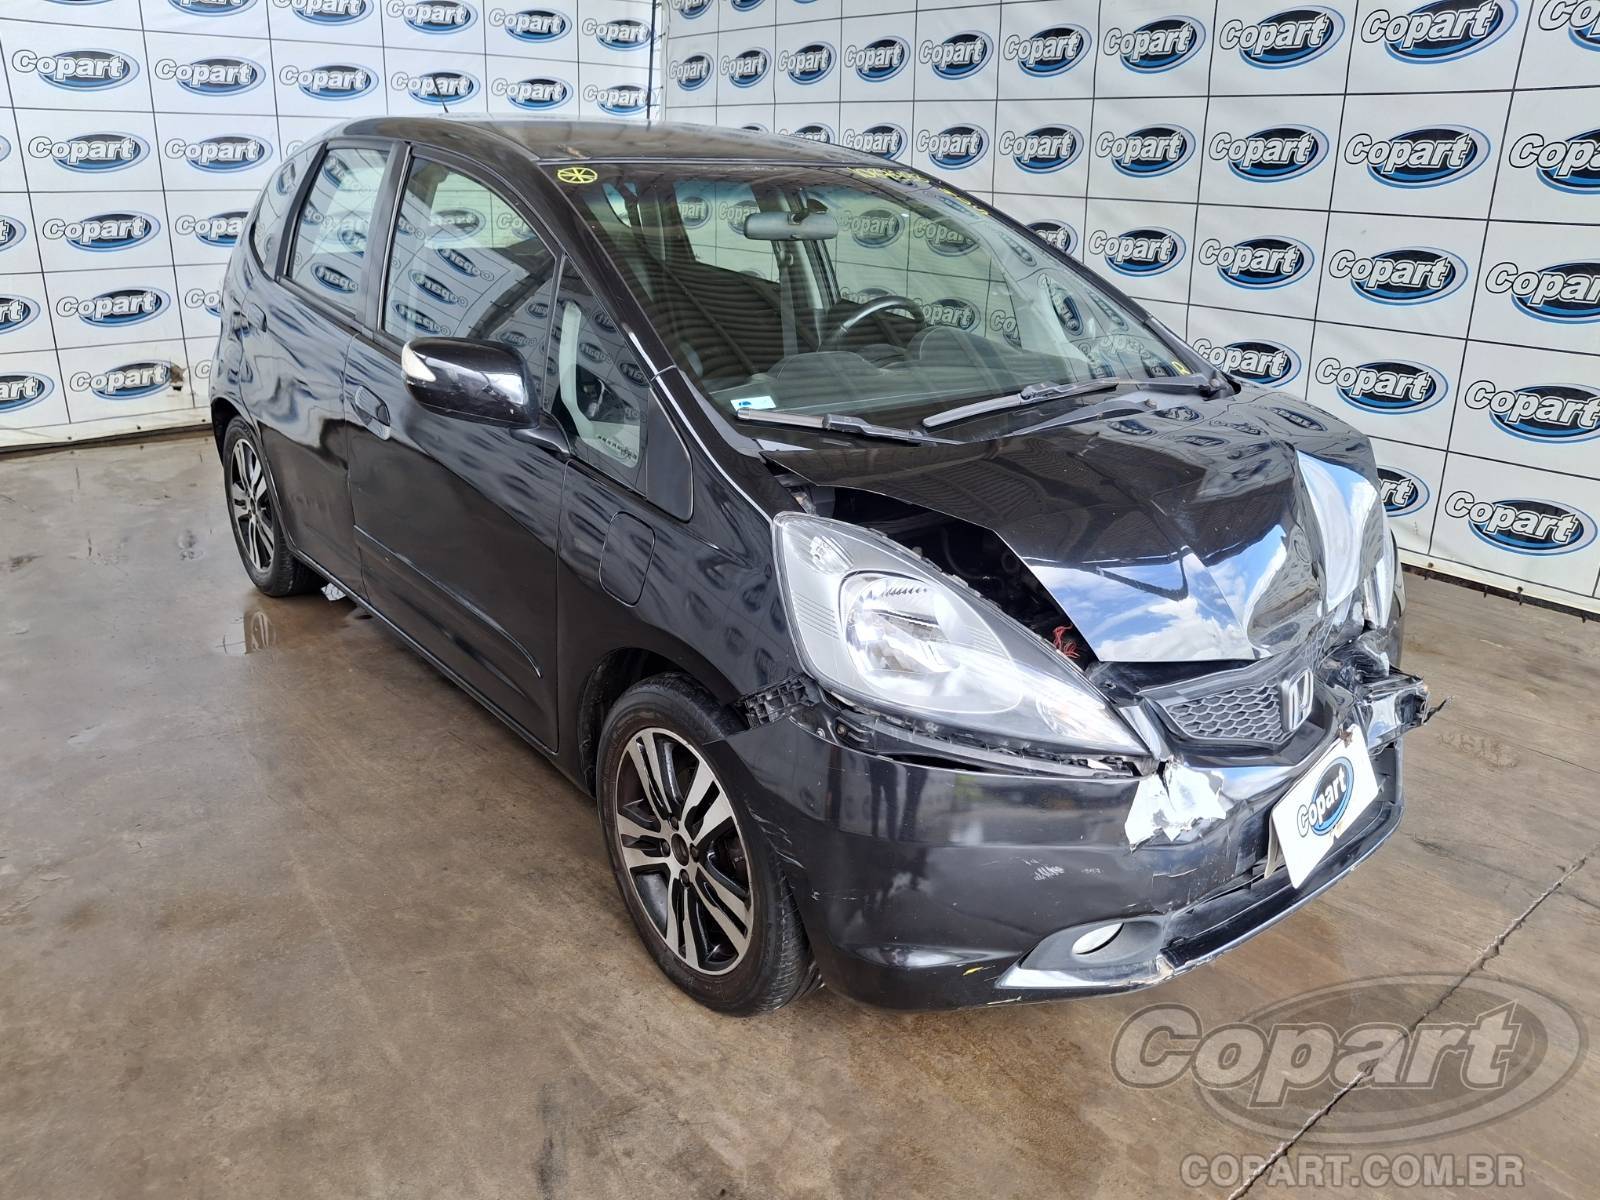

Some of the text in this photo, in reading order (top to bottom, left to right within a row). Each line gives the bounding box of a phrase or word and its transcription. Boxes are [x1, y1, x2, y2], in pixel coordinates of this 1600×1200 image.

[386, 0, 466, 25] Copart
[489, 8, 563, 35] Copart
[1361, 0, 1497, 49] Copart
[582, 18, 648, 43] Copart
[1103, 22, 1193, 62] Copart
[1220, 12, 1329, 56] Copart
[778, 45, 829, 76] Copart
[844, 40, 903, 72] Copart
[919, 36, 985, 66] Copart
[1004, 30, 1081, 65] Copart
[12, 49, 124, 80] Copart
[155, 59, 251, 85] Copart
[279, 65, 368, 93] Copart
[669, 57, 708, 84] Copart
[720, 50, 764, 80] Copart
[390, 71, 469, 96] Copart
[491, 78, 565, 103] Copart
[583, 84, 647, 109] Copart
[28, 136, 137, 164] Copart
[165, 138, 259, 164] Copart
[842, 128, 900, 153] Copart
[916, 129, 981, 156] Copart
[999, 131, 1073, 162] Copart
[1095, 131, 1182, 165] Copart
[1210, 132, 1315, 169] Copart
[1344, 133, 1471, 173] Copart
[1509, 133, 1600, 178] Cop
[678, 201, 706, 221] part
[43, 216, 145, 245] Copart
[175, 214, 245, 240] Copa
[1089, 230, 1175, 263] Copart
[1199, 238, 1300, 275] Copart
[1329, 249, 1451, 290] Copart
[56, 291, 157, 319] Copart
[69, 362, 169, 393] Copart
[1315, 357, 1433, 401] Copart
[1465, 380, 1600, 428] Copart
[1445, 490, 1579, 543] Copart
[1297, 766, 1348, 838] Copart
